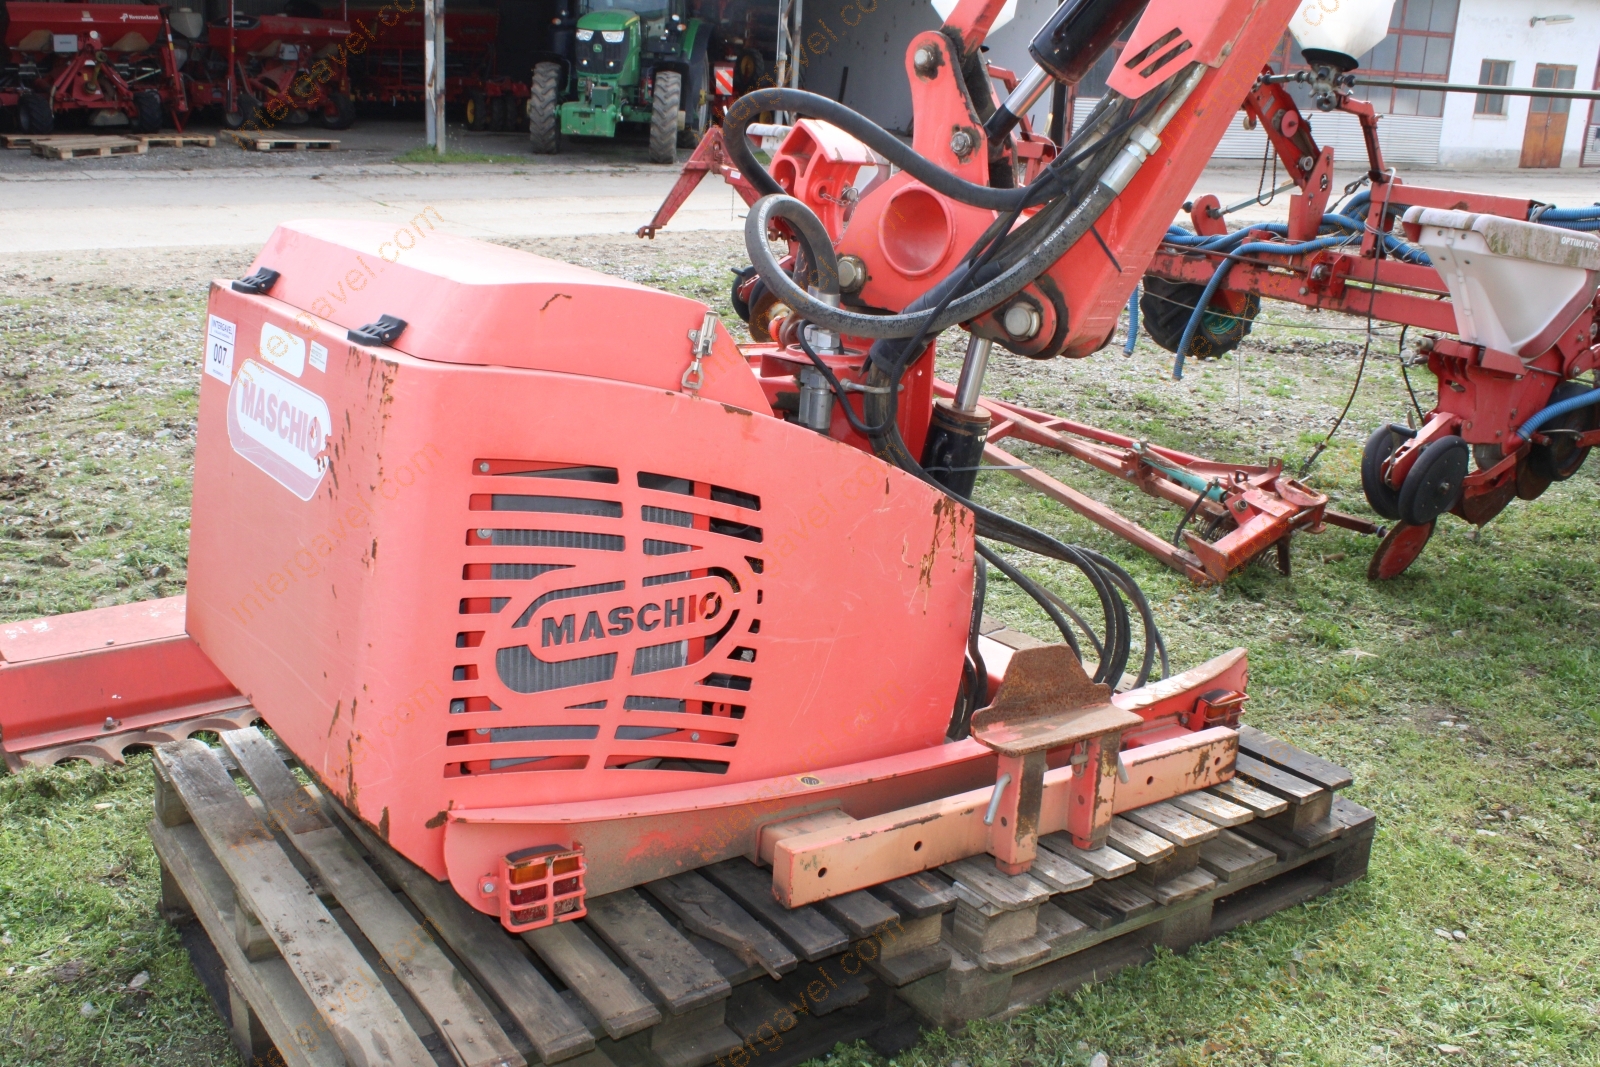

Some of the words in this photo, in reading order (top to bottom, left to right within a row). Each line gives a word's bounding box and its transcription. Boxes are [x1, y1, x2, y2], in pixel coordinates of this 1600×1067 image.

[1043, 225, 1065, 246] NORTH
[1065, 196, 1092, 224] FIGHTER
[1561, 236, 1584, 248] OPTIMA
[1585, 241, 1599, 250] NT-2
[213, 343, 227, 366] 007
[240, 377, 322, 459] MASCHIO
[541, 591, 722, 648] MASCHIO
